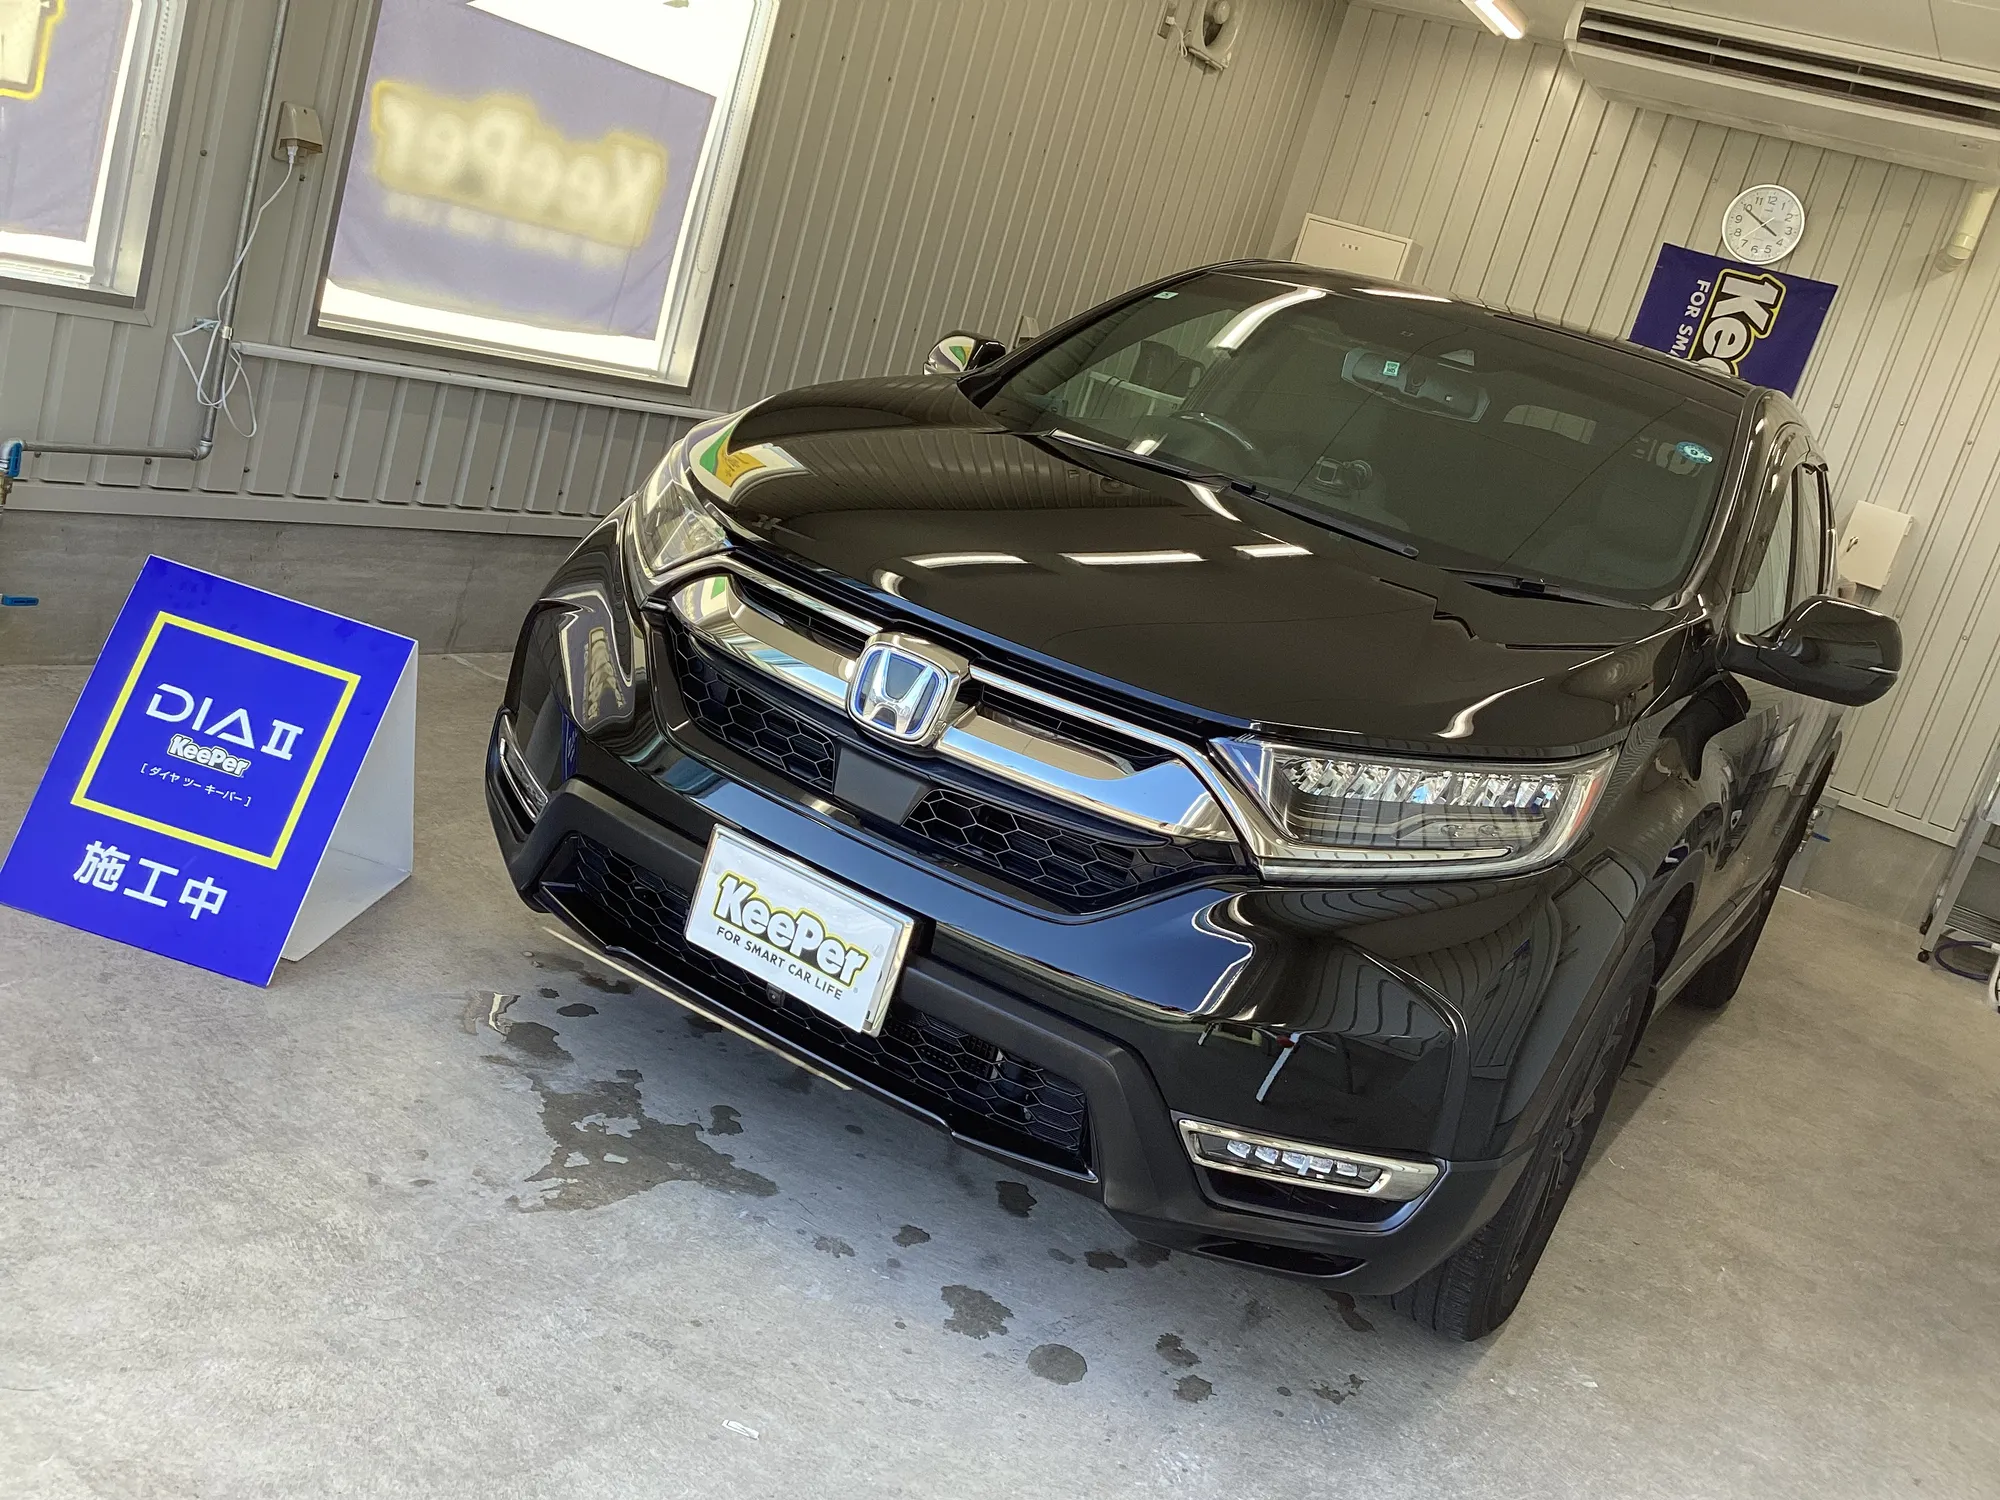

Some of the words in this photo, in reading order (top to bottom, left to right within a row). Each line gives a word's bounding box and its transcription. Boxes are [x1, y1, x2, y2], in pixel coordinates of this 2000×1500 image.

[1755, 197, 1764, 205] 11
[1768, 196, 1778, 206] 12
[1734, 214, 1743, 224] 9
[1784, 213, 1793, 222] 2
[1734, 228, 1742, 237] 8
[1785, 226, 1793, 235] 3
[1741, 239, 1749, 247] 7
[1776, 238, 1784, 246] 4
[1751, 245, 1759, 253] 6
[1764, 245, 1772, 253] 5
[1685, 279, 1711, 318] FOR
[145, 683, 255, 749] DIA
[167, 733, 251, 778] KeePer
[73, 841, 228, 920] 施工中
[714, 870, 870, 988] KeePer
[716, 926, 741, 946] FOR
[744, 940, 785, 968] SMART
[788, 963, 811, 984] CAR
[814, 977, 843, 1000] LIFE
